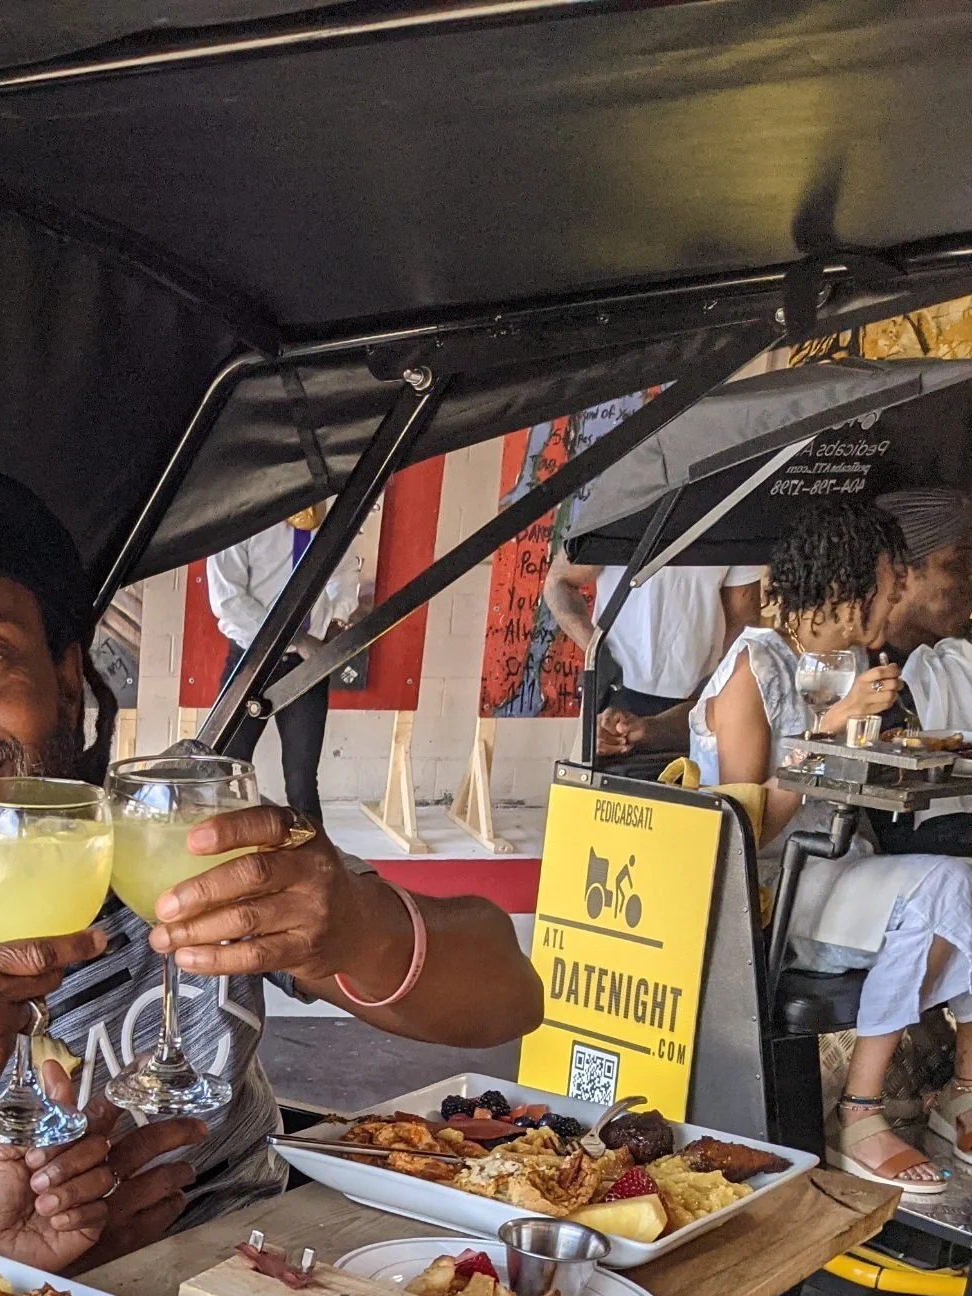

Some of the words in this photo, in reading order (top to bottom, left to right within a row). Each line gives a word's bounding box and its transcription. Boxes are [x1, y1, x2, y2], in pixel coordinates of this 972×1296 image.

[593, 798, 654, 832] PEDICABSATL
[543, 926, 565, 950] ATL
[549, 956, 683, 1033] DATENIGHT
[651, 1037, 686, 1066] .COM
